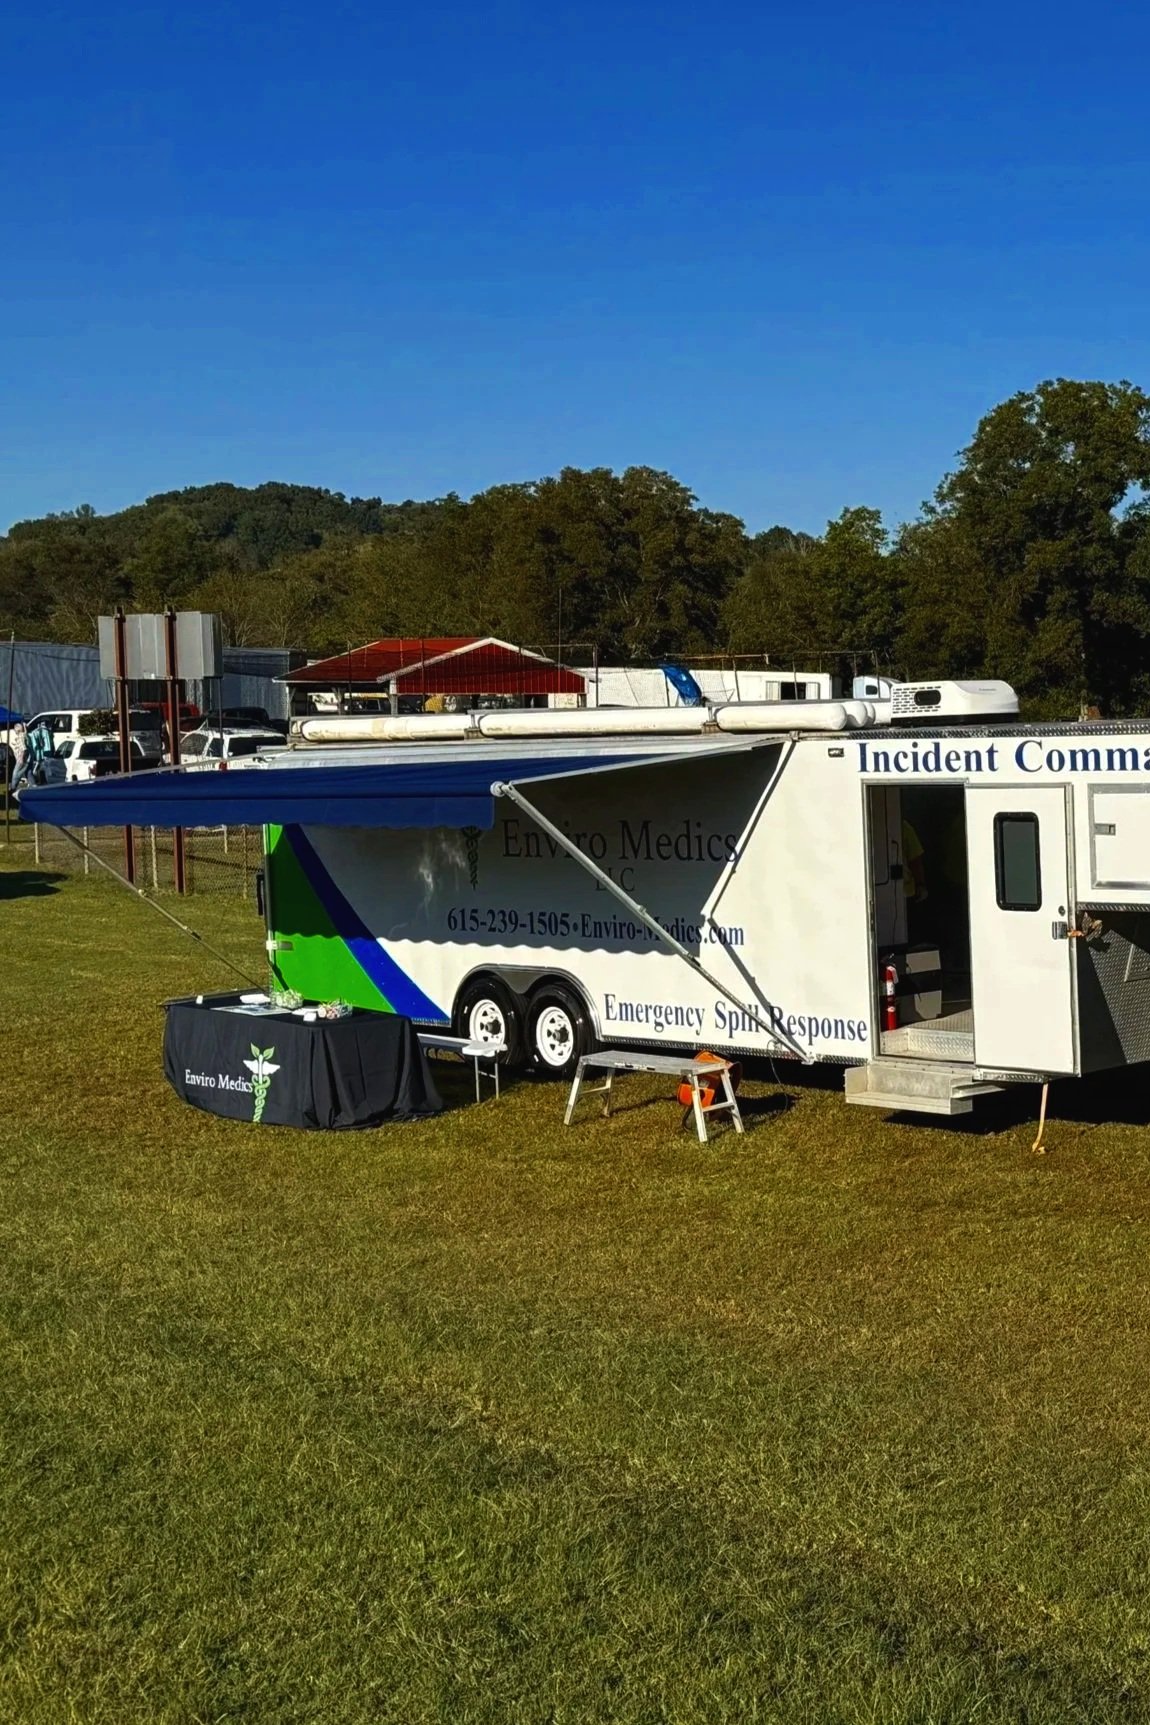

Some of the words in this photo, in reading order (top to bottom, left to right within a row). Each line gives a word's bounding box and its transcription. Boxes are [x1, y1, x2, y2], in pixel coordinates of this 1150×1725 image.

[857, 741, 999, 773] Incident
[618, 820, 738, 862] Medics
[604, 993, 705, 1036] Emergency
[714, 1000, 760, 1039] Spill
[769, 1006, 868, 1046] Response
[185, 1069, 215, 1088] Enviro
[218, 1073, 254, 1093] Medics
